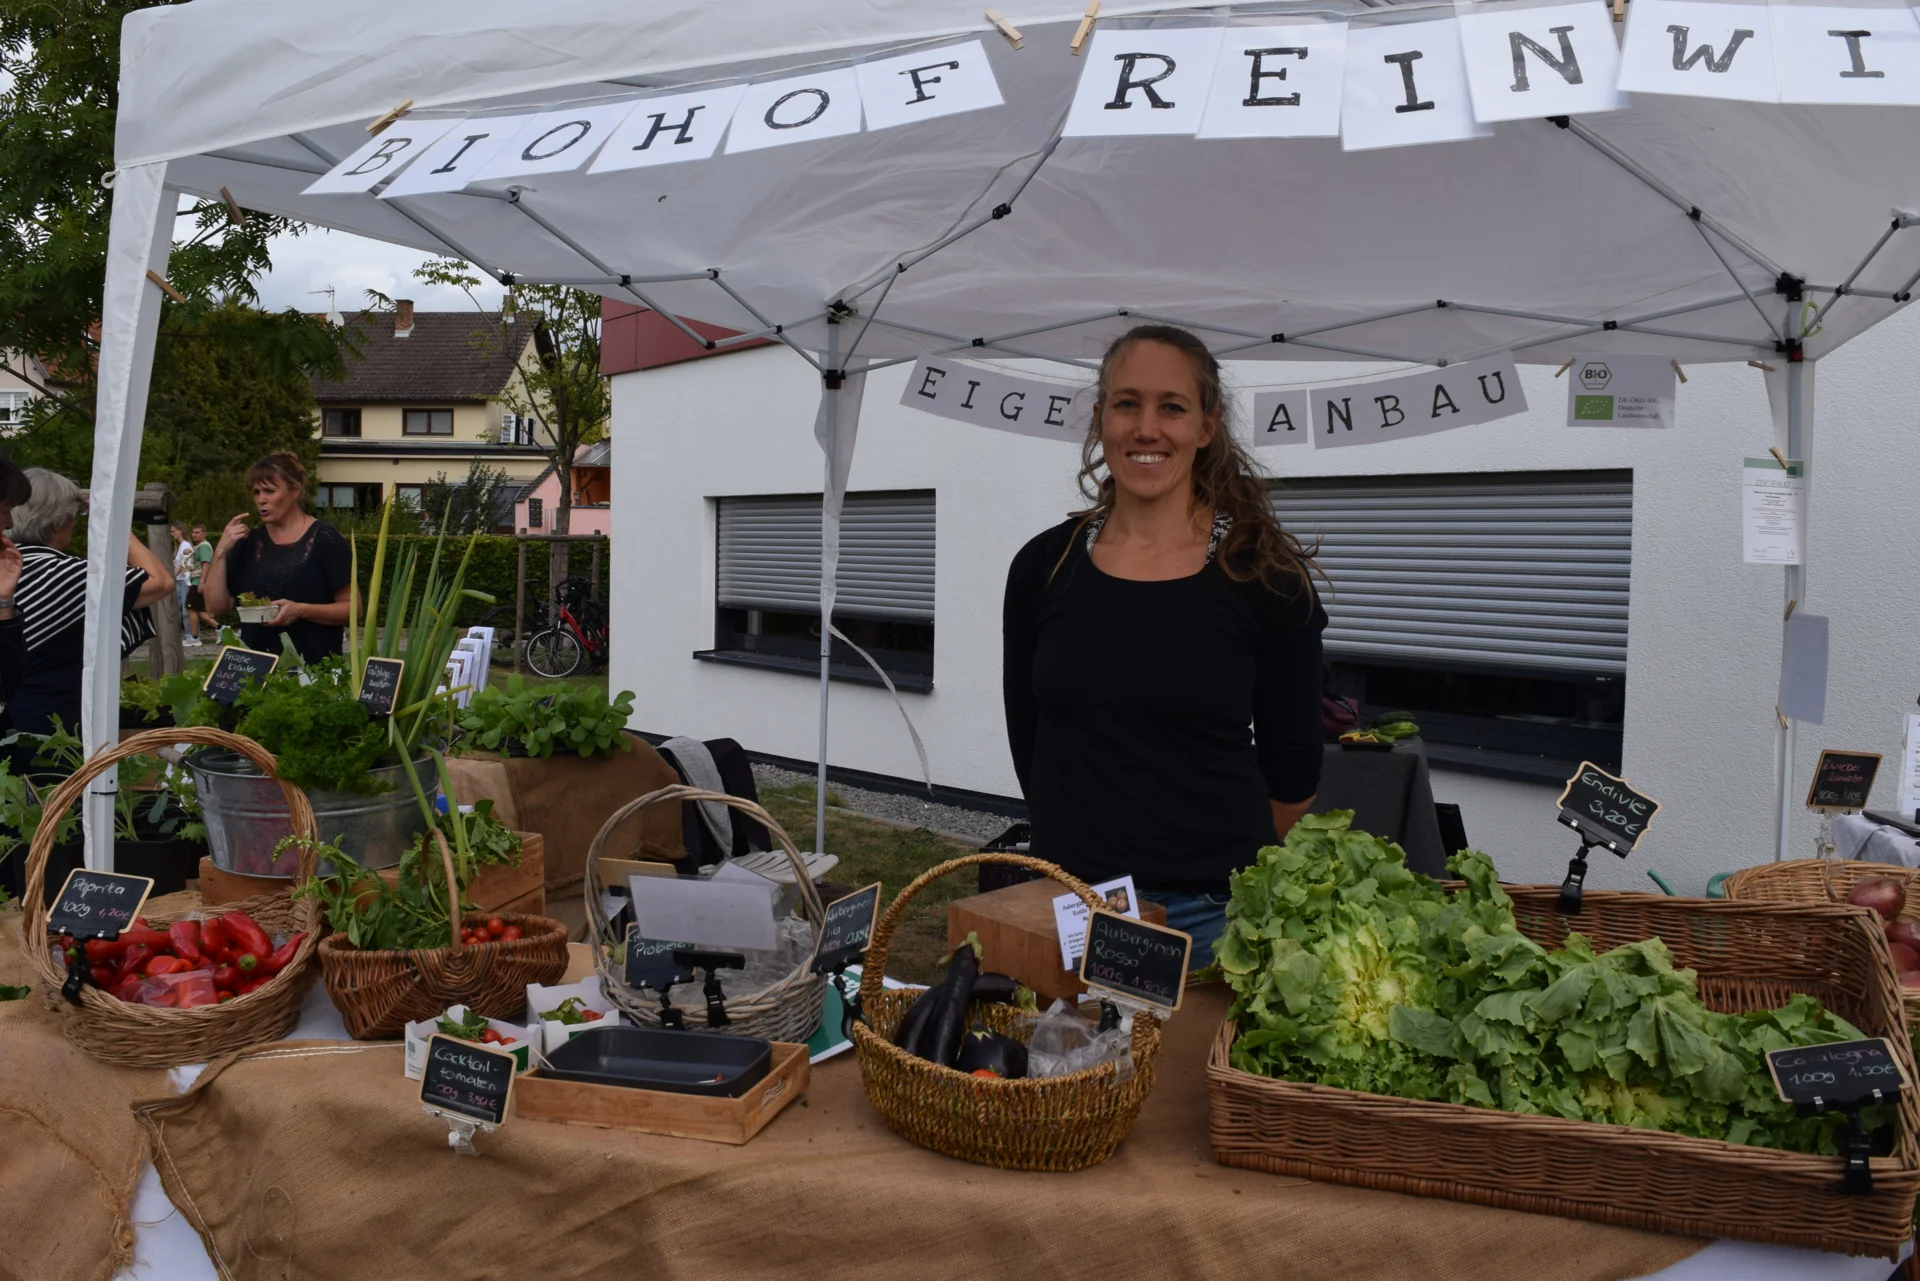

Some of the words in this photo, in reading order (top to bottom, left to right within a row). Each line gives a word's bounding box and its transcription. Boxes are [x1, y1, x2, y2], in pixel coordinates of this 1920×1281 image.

[342, 60, 960, 177] BIOHOF
[1267, 371, 1506, 434] ANBAU
[1581, 772, 1647, 816] Endivie
[72, 878, 126, 898] Paprika
[61, 901, 91, 917] 100g
[98, 908, 130, 920] 1,20€
[1094, 939, 1139, 968] Rosso
[1096, 921, 1182, 957] Auberginen
[440, 1066, 497, 1092] tomaten
[1848, 1063, 1897, 1077] 1,50€
